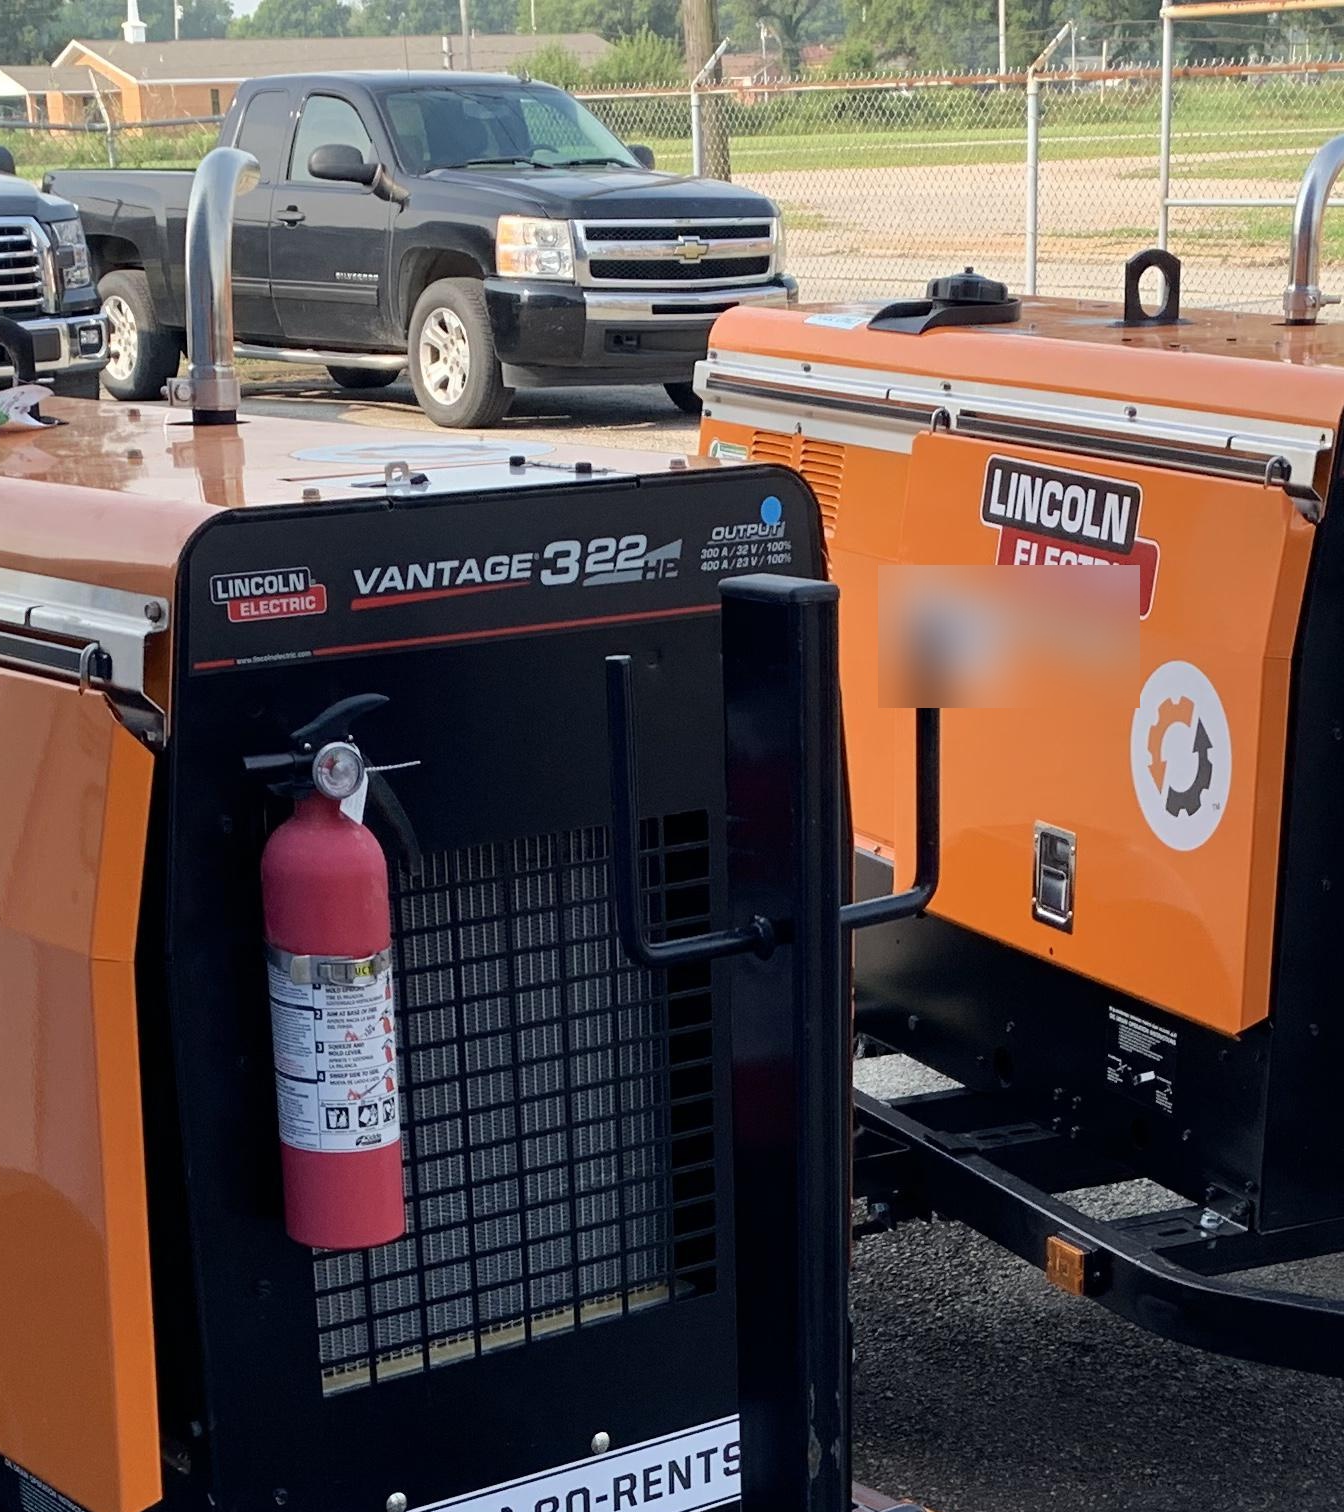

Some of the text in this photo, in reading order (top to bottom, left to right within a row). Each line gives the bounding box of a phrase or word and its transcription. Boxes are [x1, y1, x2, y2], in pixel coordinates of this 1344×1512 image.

[989, 468, 1132, 545] LINCOLN
[711, 521, 781, 542] OUTPUT
[700, 547, 720, 560] 300
[720, 546, 730, 557] A
[736, 544, 749, 556] 32
[749, 543, 759, 555] V
[766, 540, 792, 552] 100%
[352, 552, 534, 595] VANTAGE
[540, 534, 648, 587] 322
[700, 560, 720, 572] 400
[720, 559, 730, 570] A
[736, 557, 750, 569] 23
[749, 556, 758, 568] V
[216, 572, 305, 600] LINCOLN
[239, 595, 317, 618] ELECTRIC
